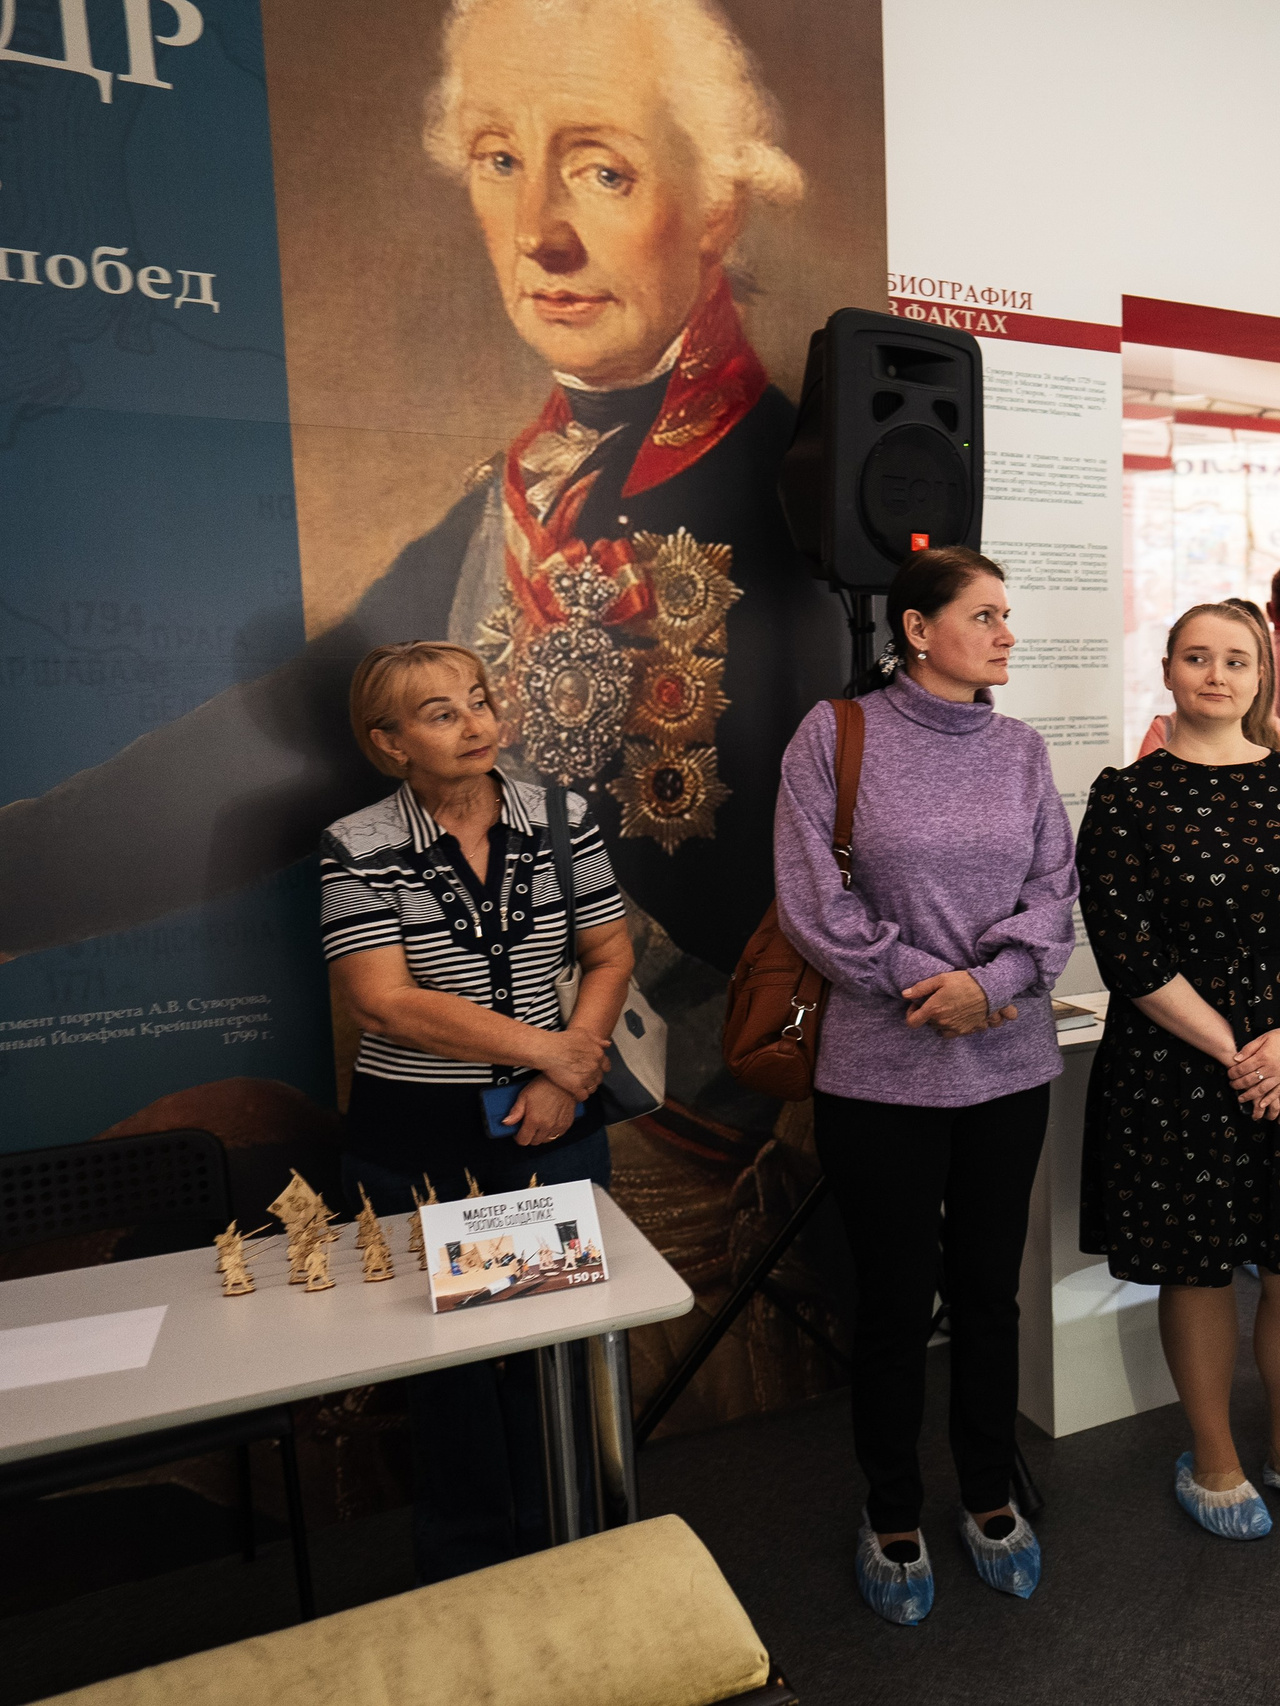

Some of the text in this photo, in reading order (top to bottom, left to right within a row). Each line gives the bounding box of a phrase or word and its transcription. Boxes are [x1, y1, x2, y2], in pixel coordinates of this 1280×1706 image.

[0, 246, 221, 314] побед
[887, 272, 1034, 311] БИОГРАФИЯ
[904, 303, 1008, 334] ФАКТАХ
[60, 1007, 144, 1026] портрета
[149, 1000, 184, 1016] А.В.
[187, 994, 272, 1014] Суворова,
[51, 1027, 137, 1046] Йозефом
[221, 1028, 258, 1045] 1799
[463, 1204, 508, 1222] МАСТЕР
[517, 1197, 554, 1212] КЛАСС
[566, 1271, 604, 1284] 150 р.
